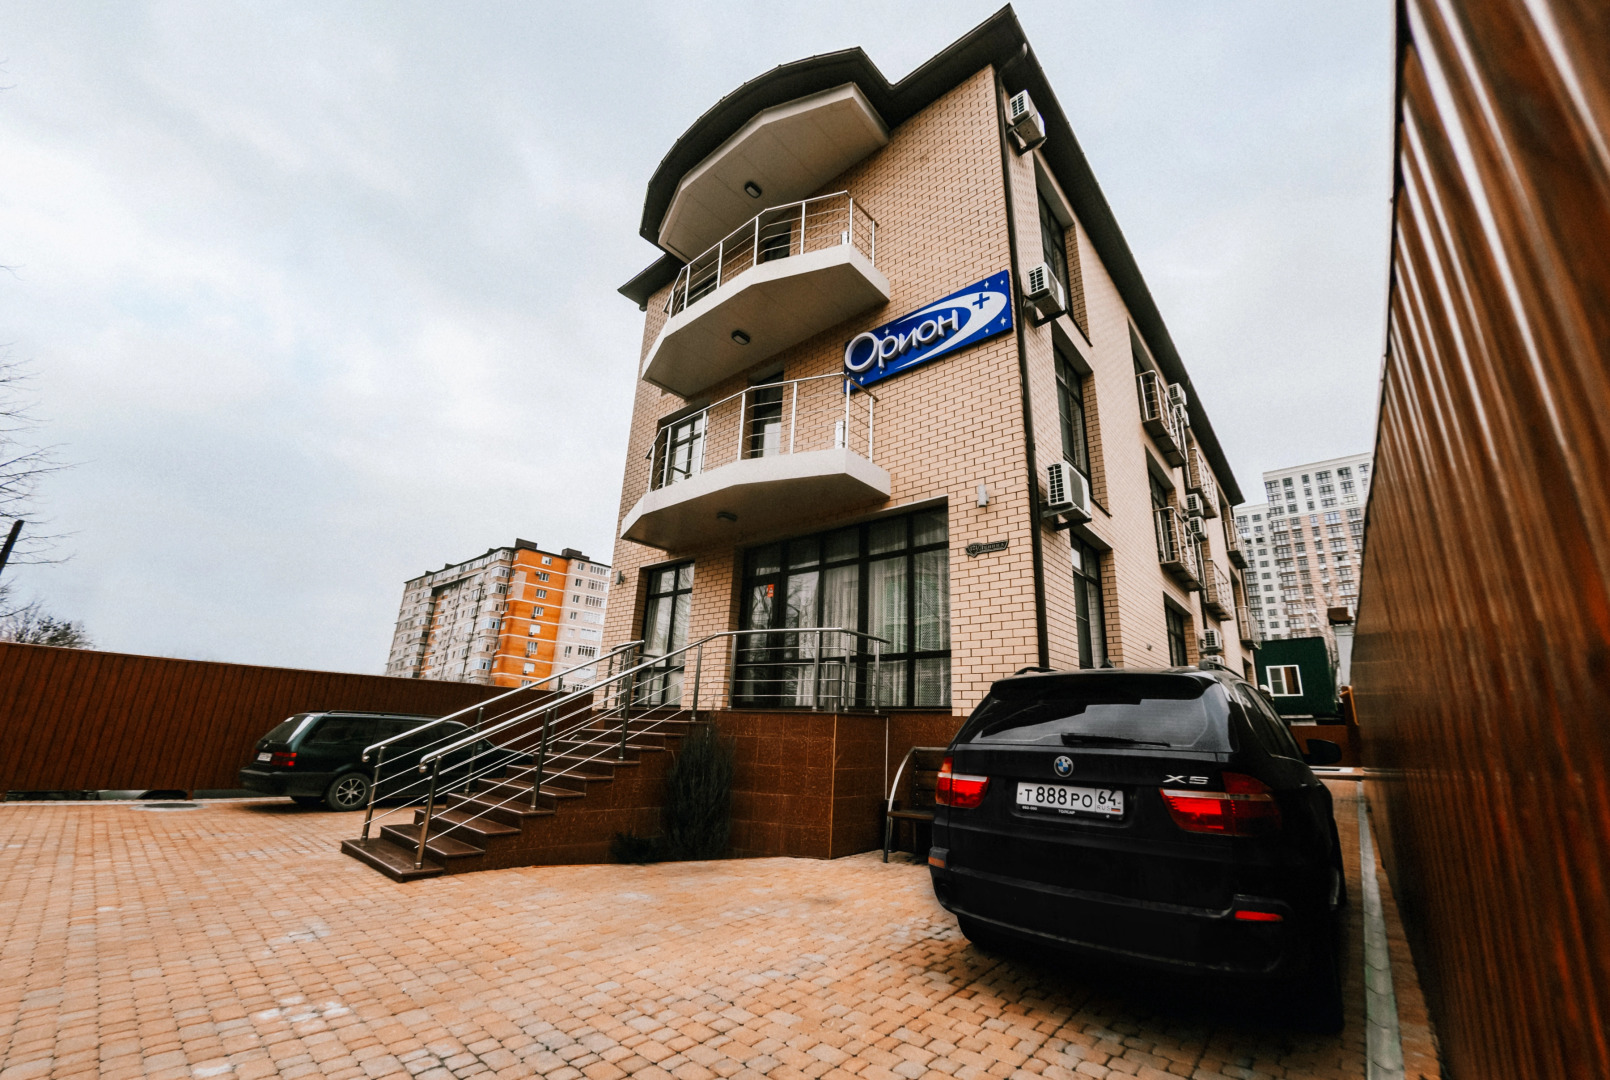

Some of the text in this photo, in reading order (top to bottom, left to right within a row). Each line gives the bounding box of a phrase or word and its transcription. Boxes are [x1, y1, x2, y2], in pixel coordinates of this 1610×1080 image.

[844, 309, 959, 373] Орион
[1162, 774, 1209, 785] X5
[1097, 789, 1117, 806] 64
